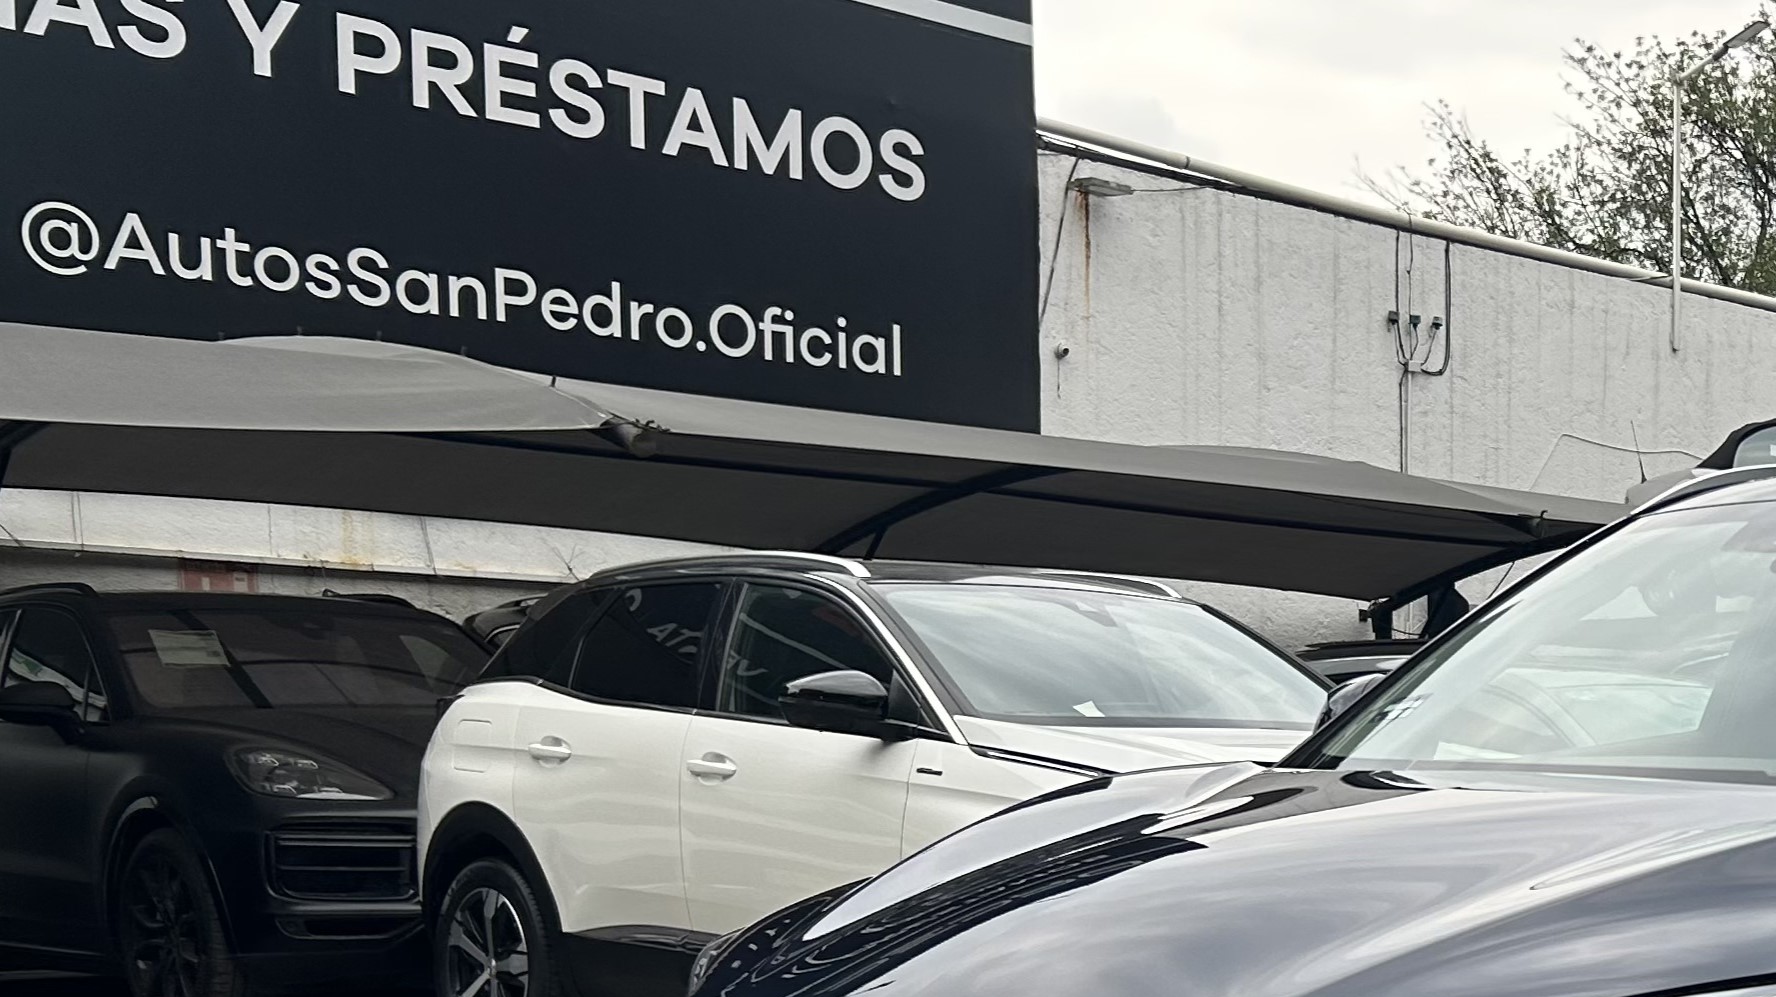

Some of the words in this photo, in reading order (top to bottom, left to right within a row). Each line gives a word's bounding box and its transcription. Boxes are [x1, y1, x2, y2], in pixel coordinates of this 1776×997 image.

[228, 0, 300, 77] Y
[336, 12, 926, 201] PRÉSTAMOS
[21, 201, 902, 376] @AutosSanPedro.Oficial
